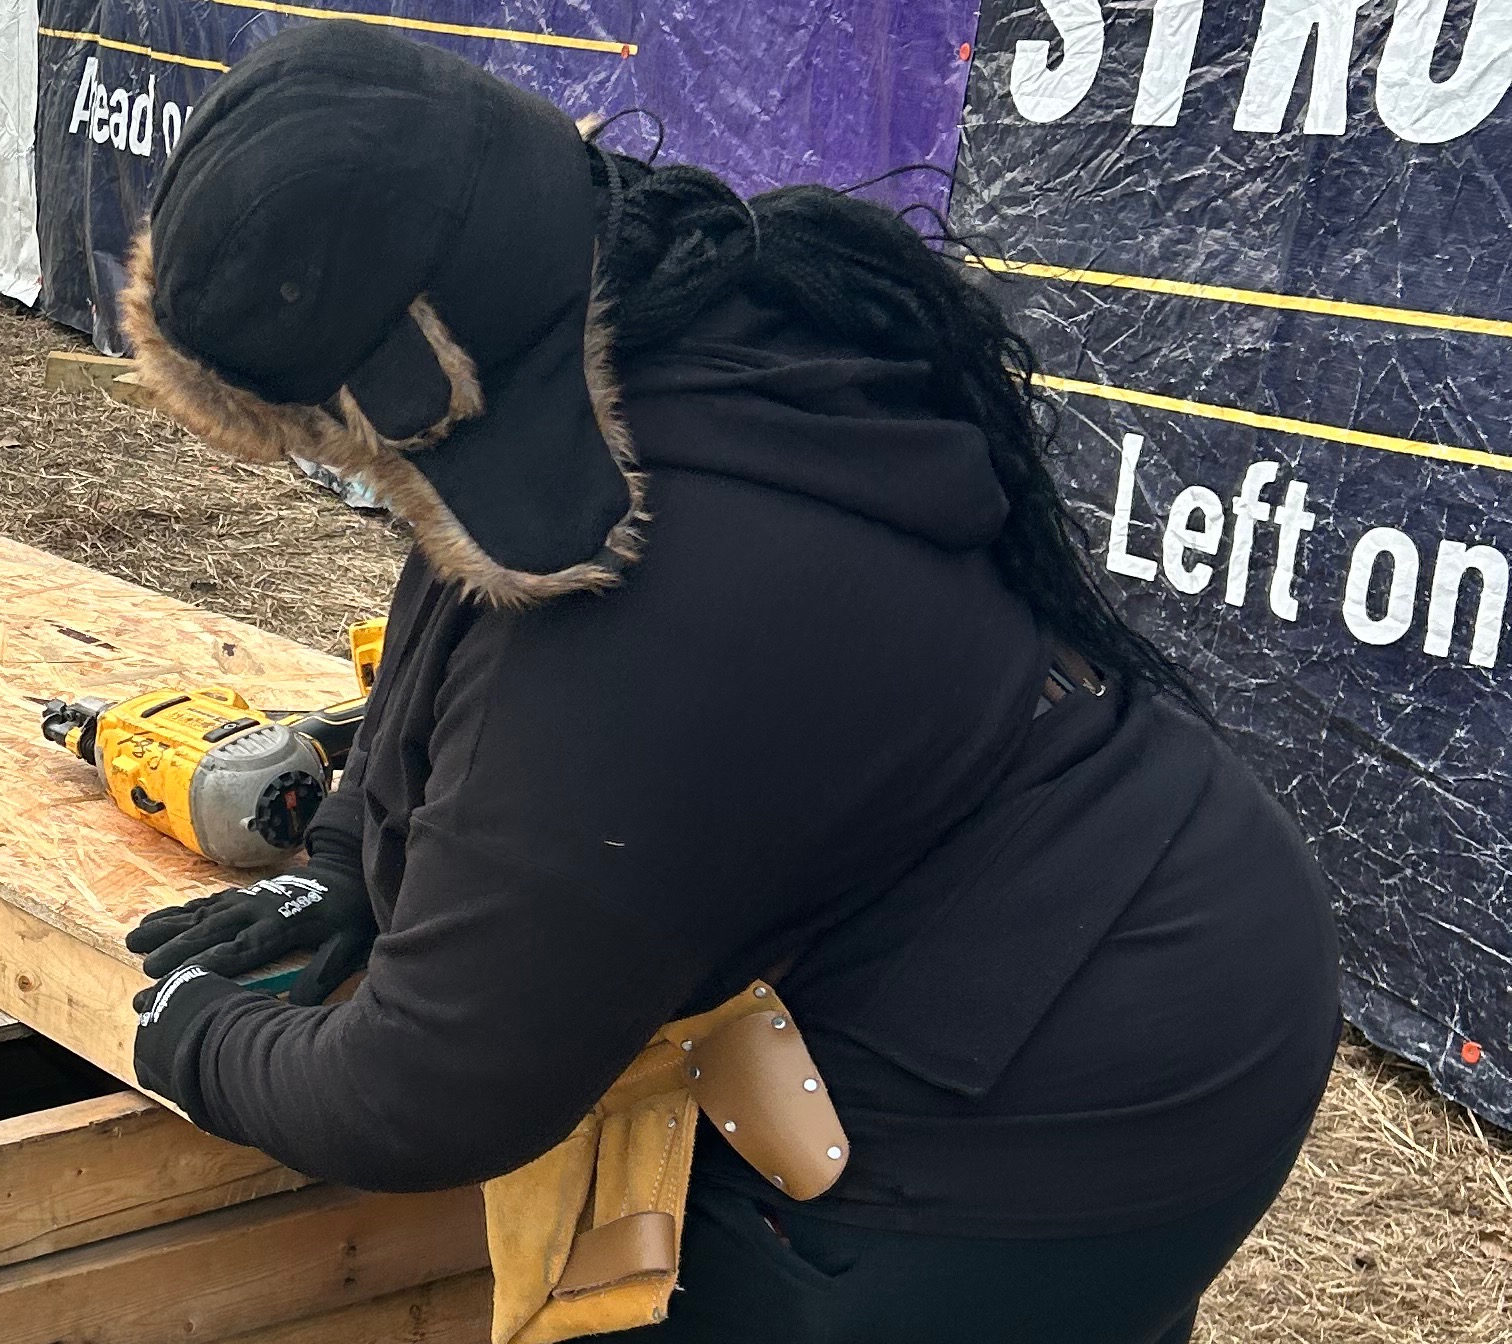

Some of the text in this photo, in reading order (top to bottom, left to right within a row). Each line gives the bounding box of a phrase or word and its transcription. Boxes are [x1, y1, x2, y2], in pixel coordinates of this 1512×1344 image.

[162, 101, 194, 158] o
[1106, 432, 1510, 669] Left on
